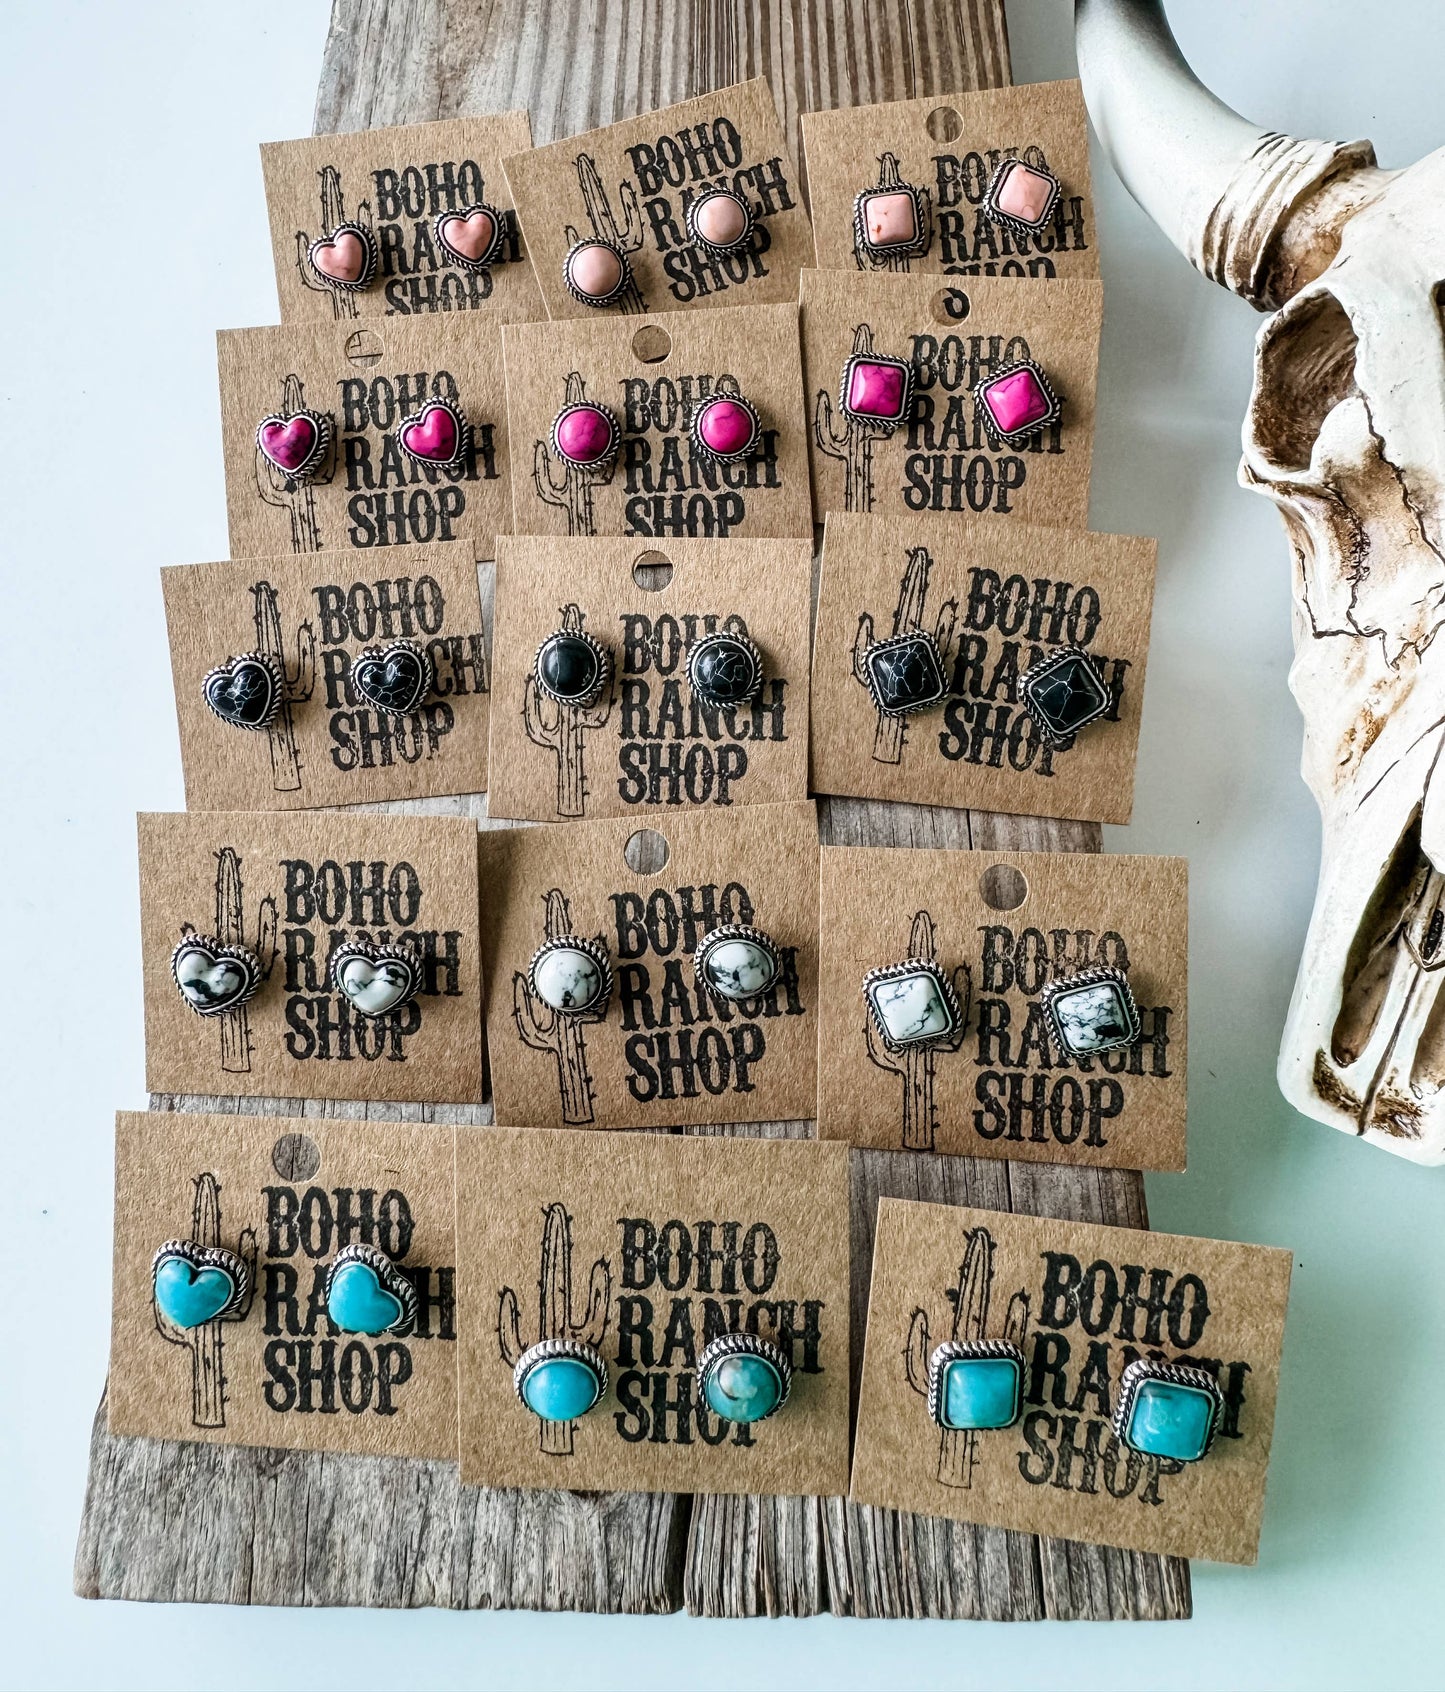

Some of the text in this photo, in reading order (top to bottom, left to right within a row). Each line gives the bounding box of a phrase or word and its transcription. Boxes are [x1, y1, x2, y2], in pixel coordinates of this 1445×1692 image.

[624, 117, 742, 197] BOHO
[348, 485, 465, 548] SHOP
[624, 491, 745, 538] SHOP
[901, 454, 1026, 514] SHOP
[311, 575, 446, 645] BOHO
[963, 567, 1102, 646] BOHO
[329, 701, 454, 771] SHOP
[617, 742, 748, 805] SHOP
[279, 859, 423, 927] BOHO
[284, 994, 422, 1062] SHOP
[625, 1023, 766, 1103] SHOP
[972, 1069, 1125, 1147] SHOP
[261, 1186, 416, 1261] BOHO
[616, 1218, 781, 1295] BOHO
[1035, 1251, 1212, 1349] BOHO
[262, 1339, 413, 1416] SHOP
